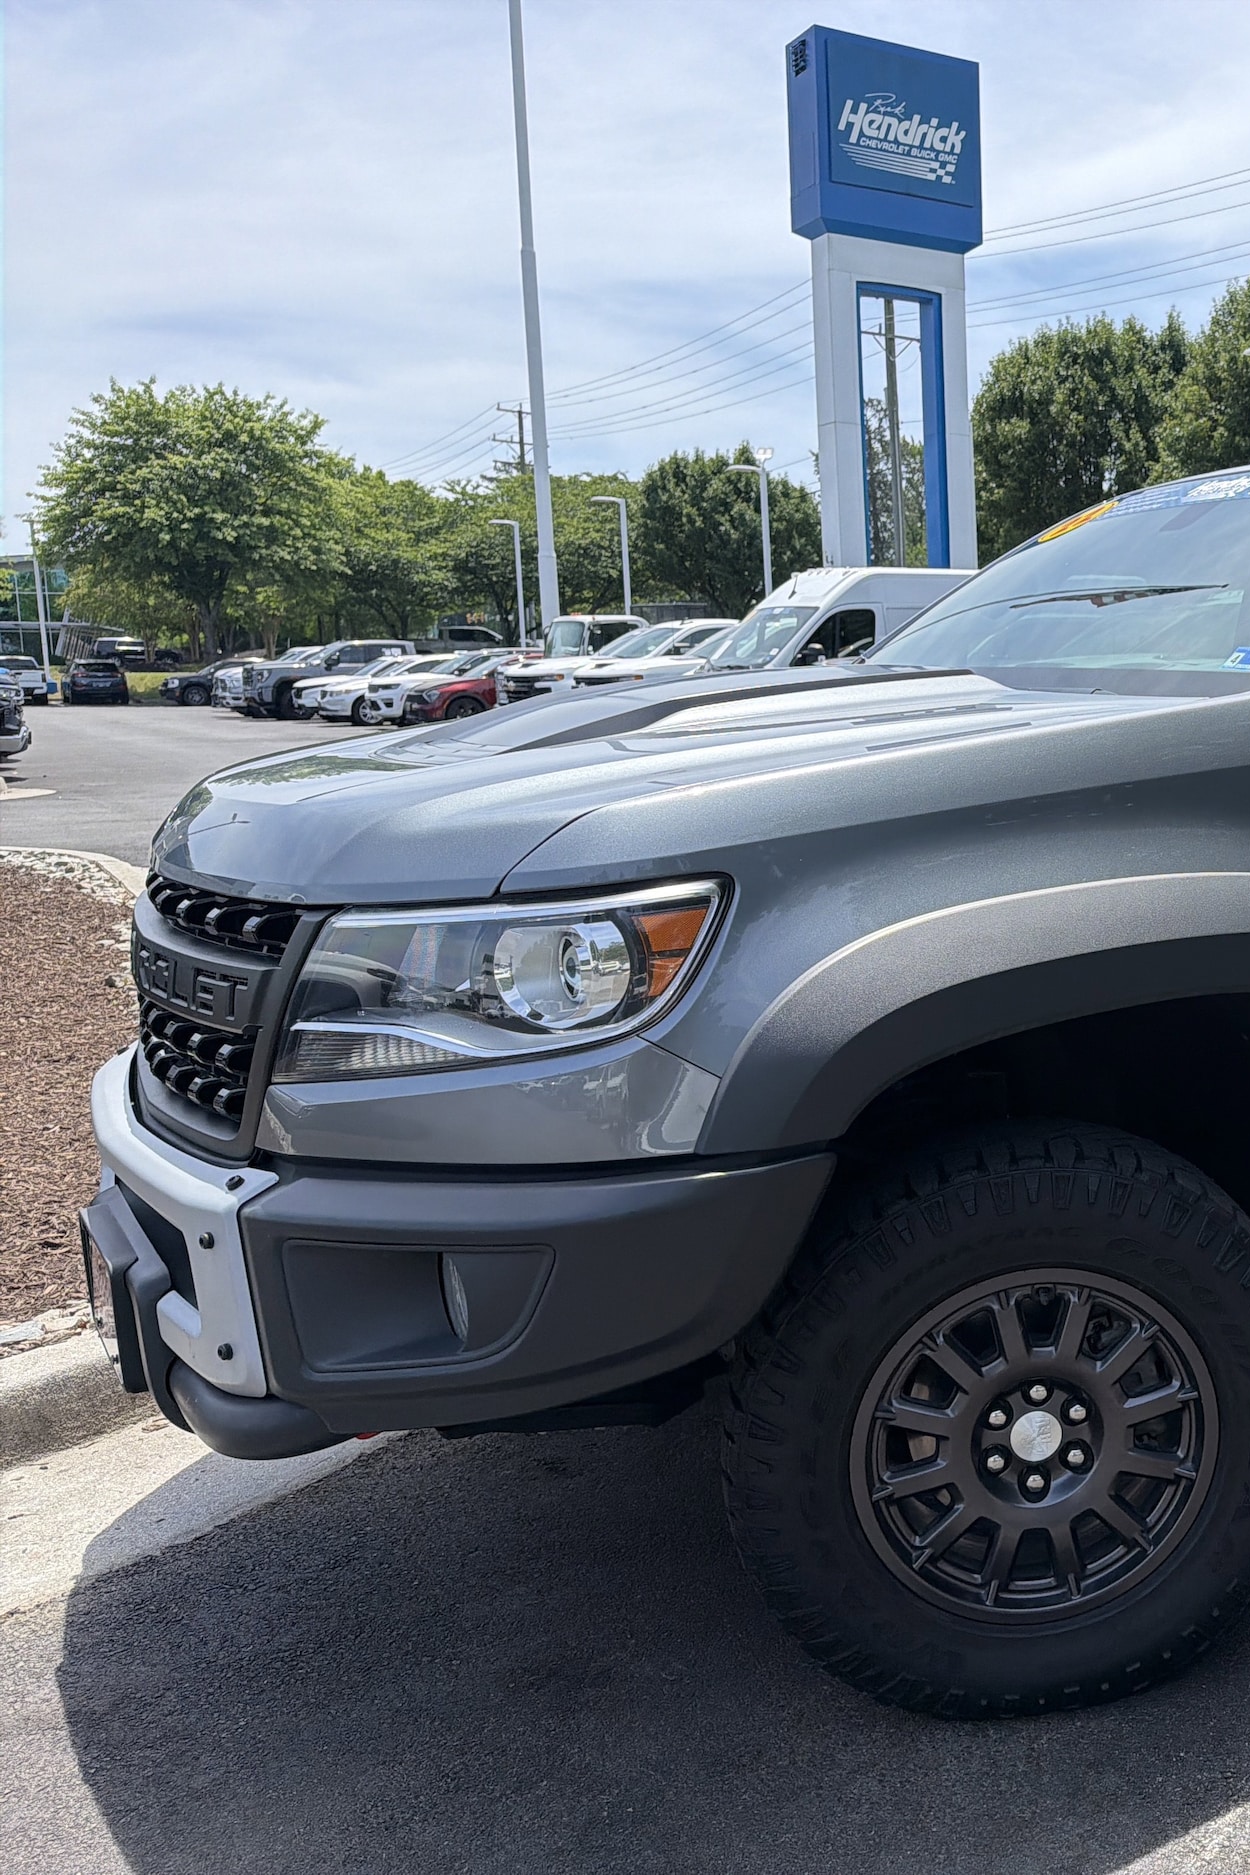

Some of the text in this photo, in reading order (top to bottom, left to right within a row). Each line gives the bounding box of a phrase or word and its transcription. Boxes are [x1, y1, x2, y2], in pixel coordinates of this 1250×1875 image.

[865, 92, 907, 119] Rick
[837, 98, 967, 154] Hendrick
[859, 137, 959, 163] CHEVROLET BUICK GMC
